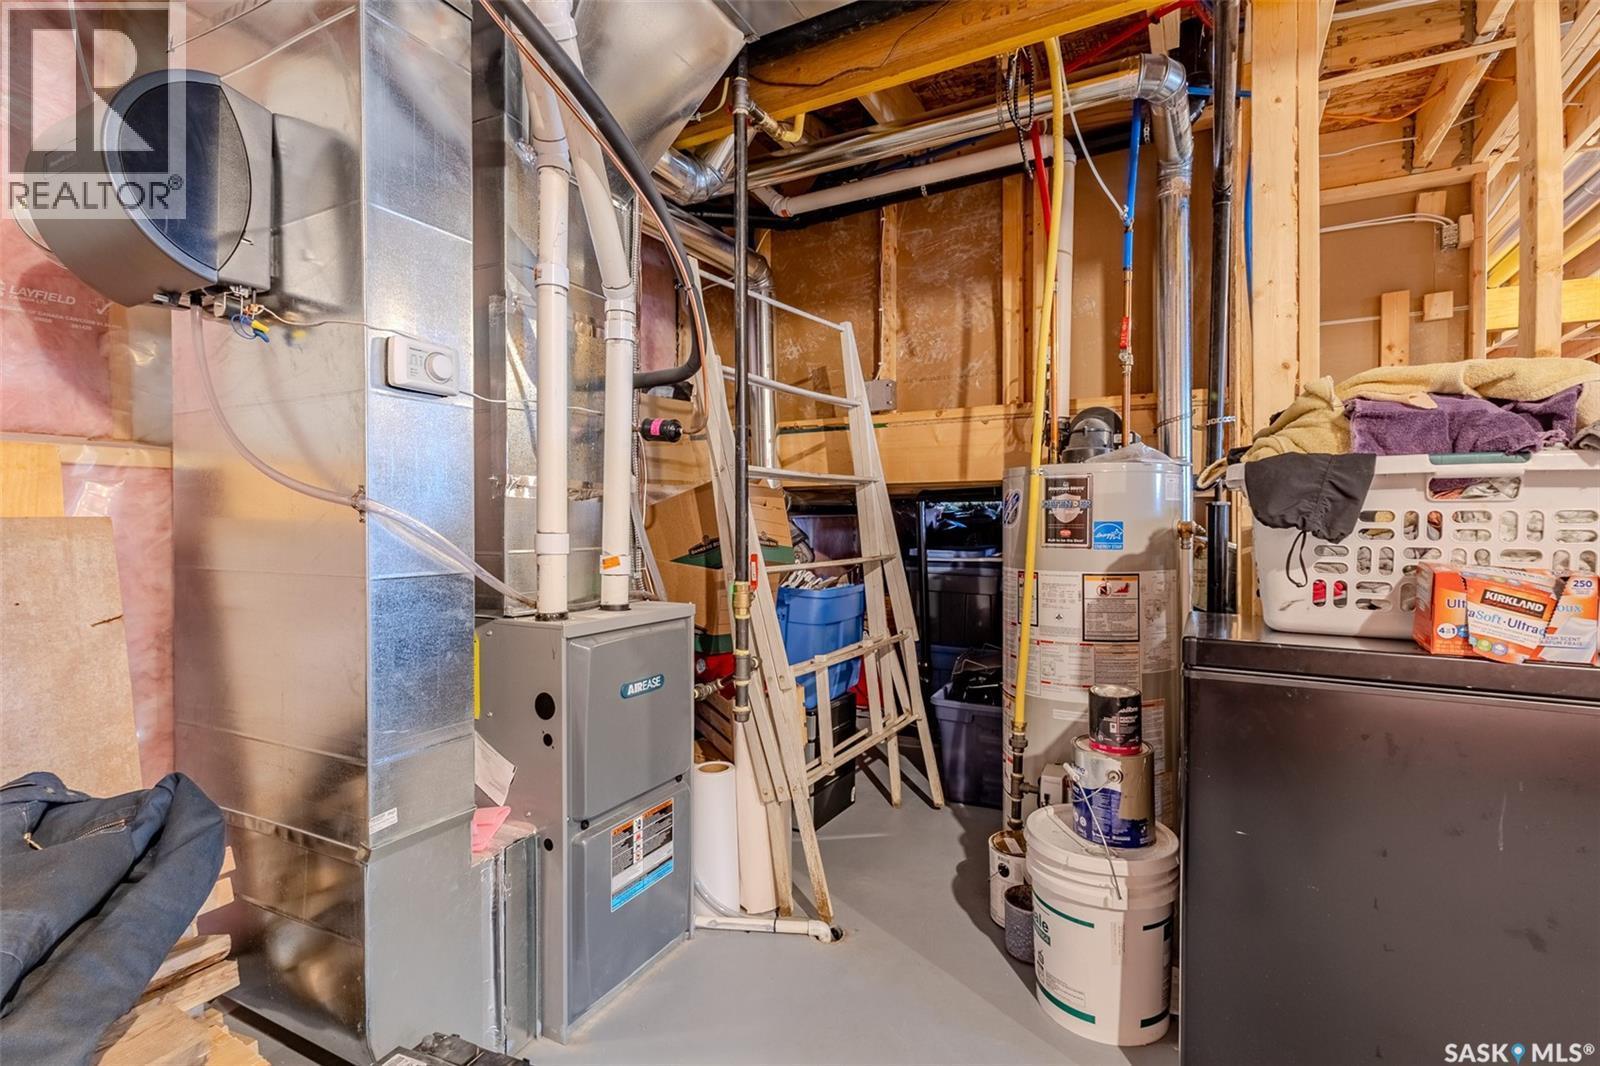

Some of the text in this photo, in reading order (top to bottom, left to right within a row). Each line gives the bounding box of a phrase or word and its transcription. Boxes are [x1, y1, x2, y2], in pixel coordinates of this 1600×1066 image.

[10, 285, 76, 305] LAYFIELD
[1573, 580, 1593, 588] 250
[1485, 591, 1545, 612] KIRKLAND
[627, 676, 661, 696] AIREASE
